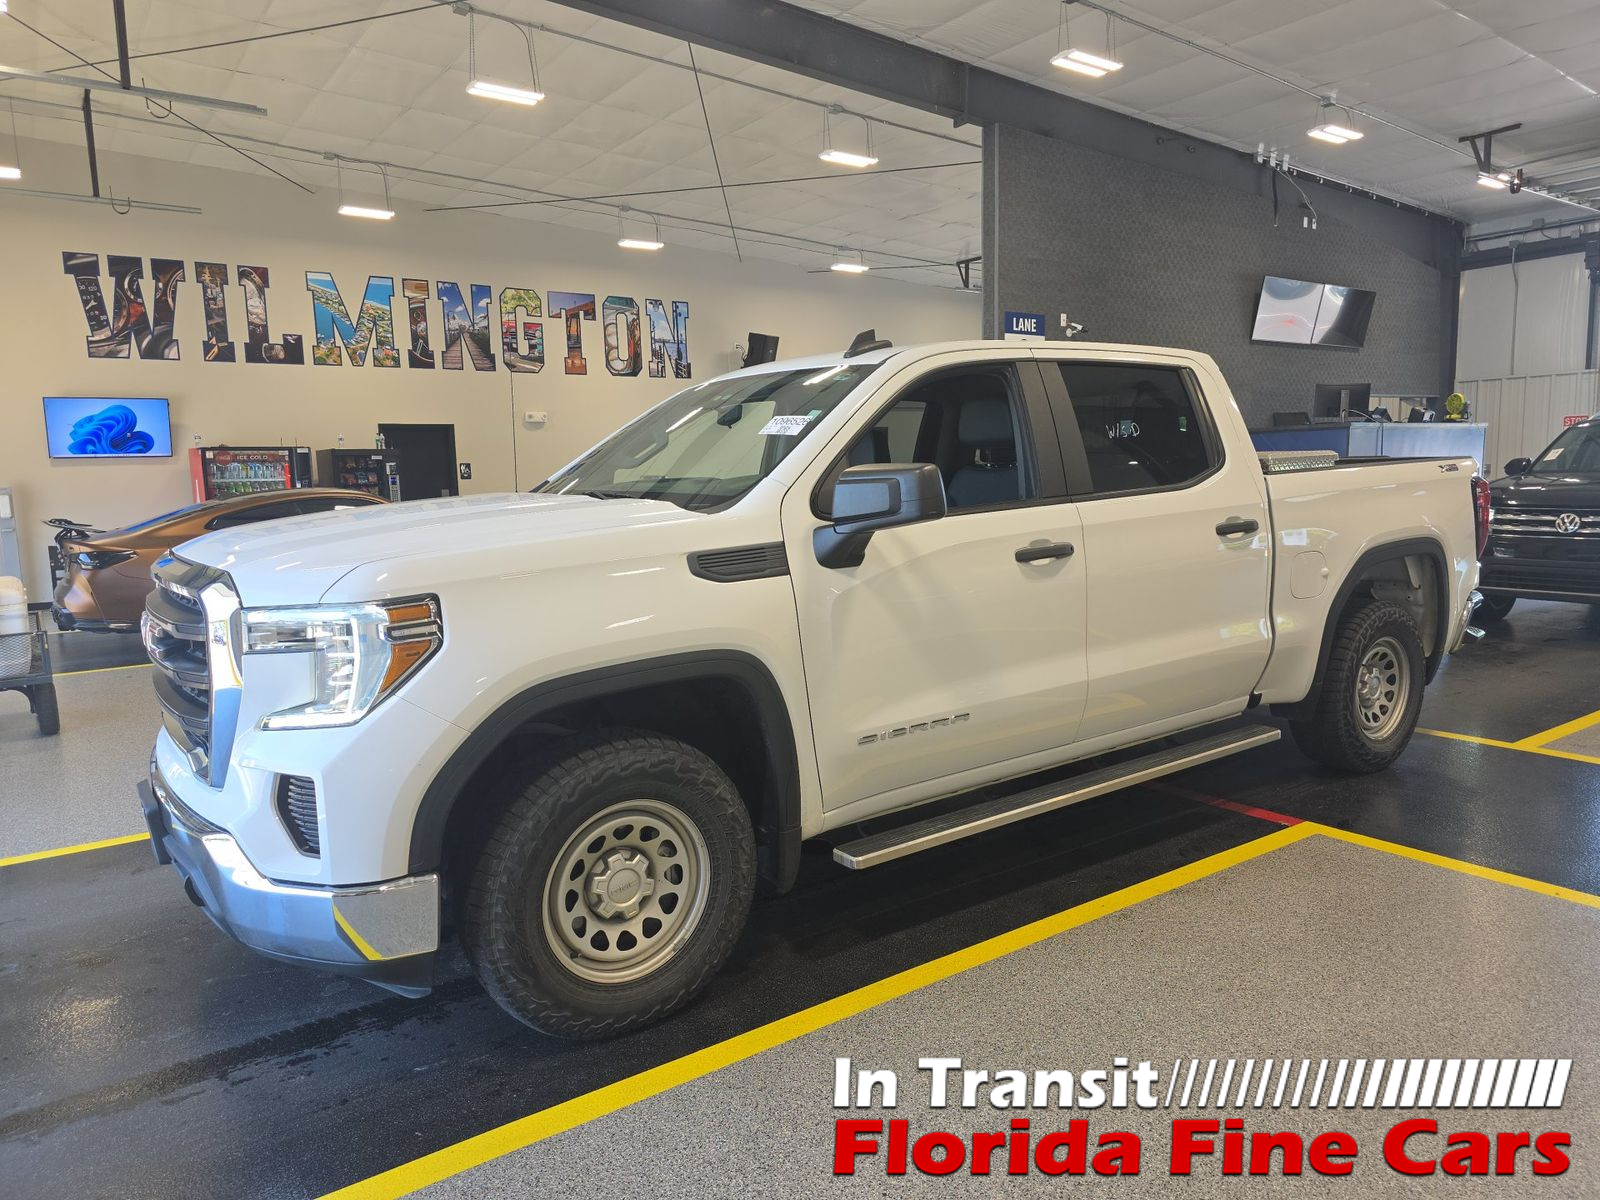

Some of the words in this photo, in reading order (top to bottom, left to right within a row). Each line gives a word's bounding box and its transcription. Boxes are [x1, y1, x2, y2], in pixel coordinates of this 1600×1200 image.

[62, 251, 692, 379] WILMINGTON
[1012, 317, 1037, 332] LANE
[857, 712, 970, 746] SIERRA
